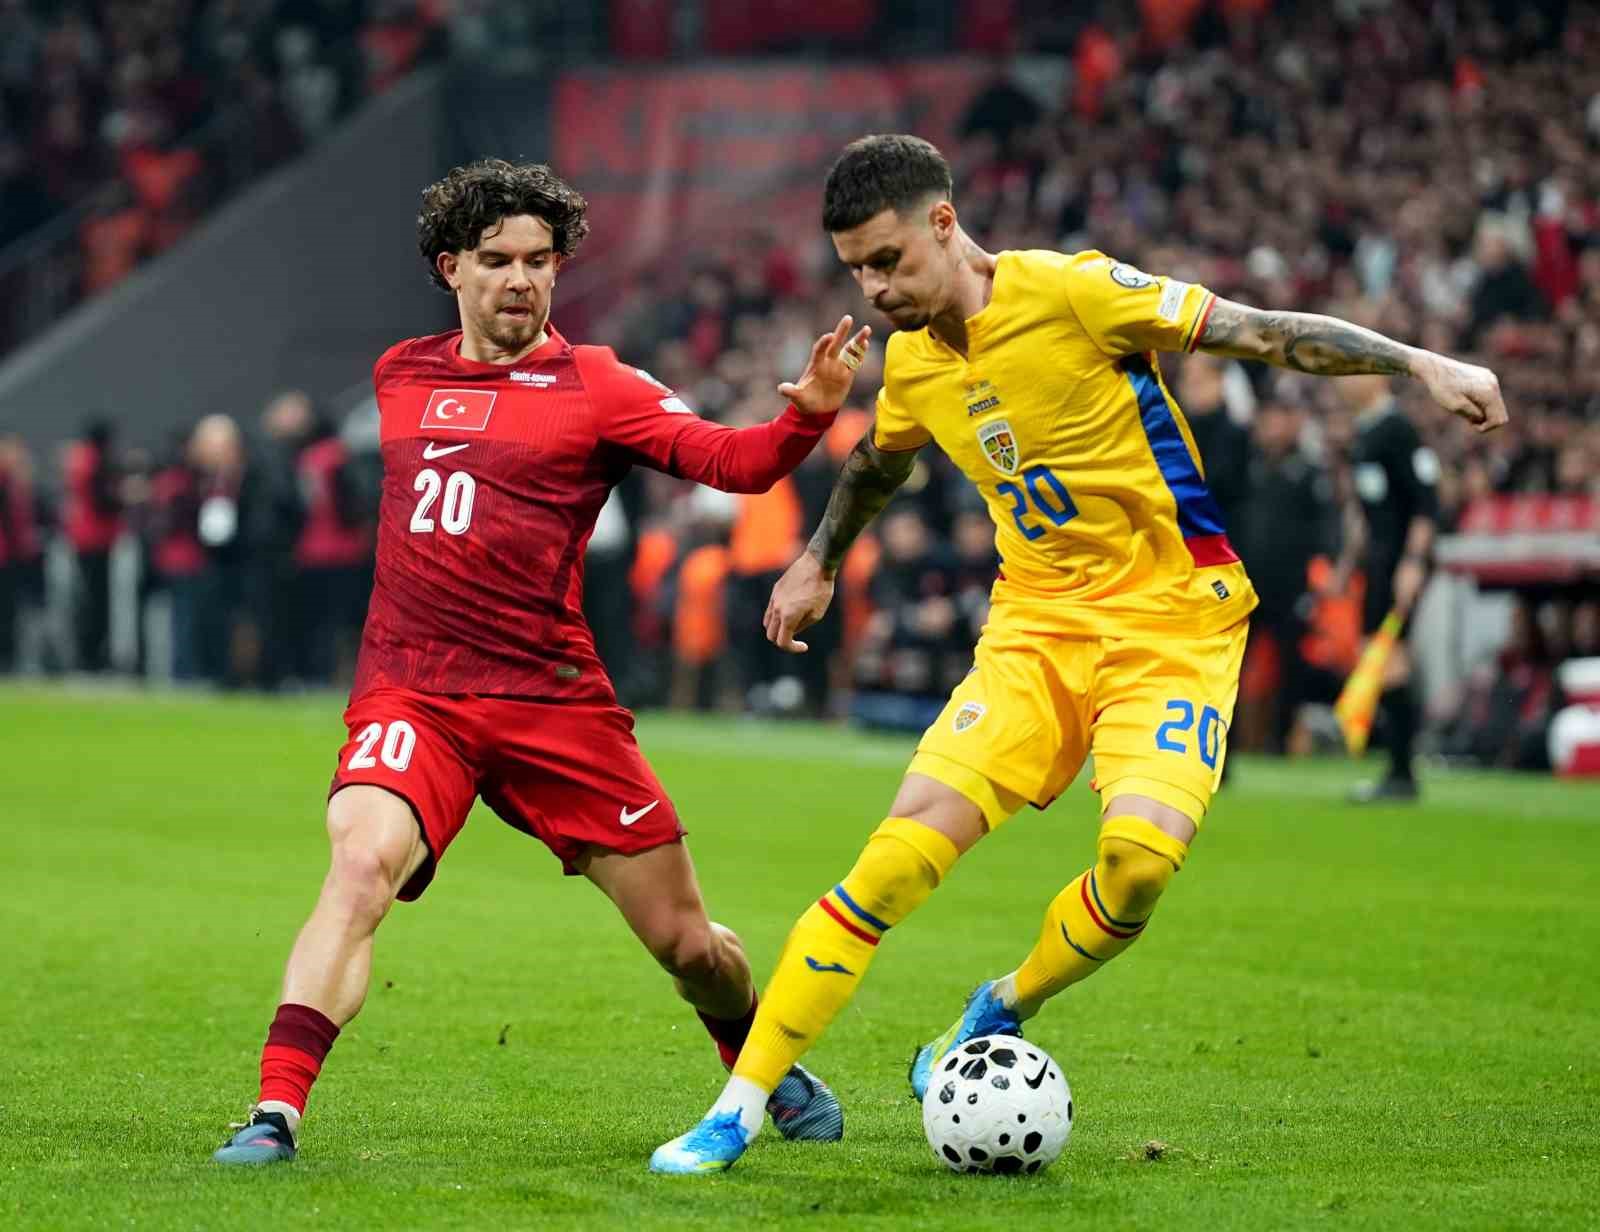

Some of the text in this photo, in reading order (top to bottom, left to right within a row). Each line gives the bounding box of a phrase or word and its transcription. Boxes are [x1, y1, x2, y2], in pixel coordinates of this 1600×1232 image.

[409, 468, 476, 536] 20
[996, 464, 1080, 541] 20
[347, 719, 417, 772] 20
[1155, 699, 1219, 770] 20
